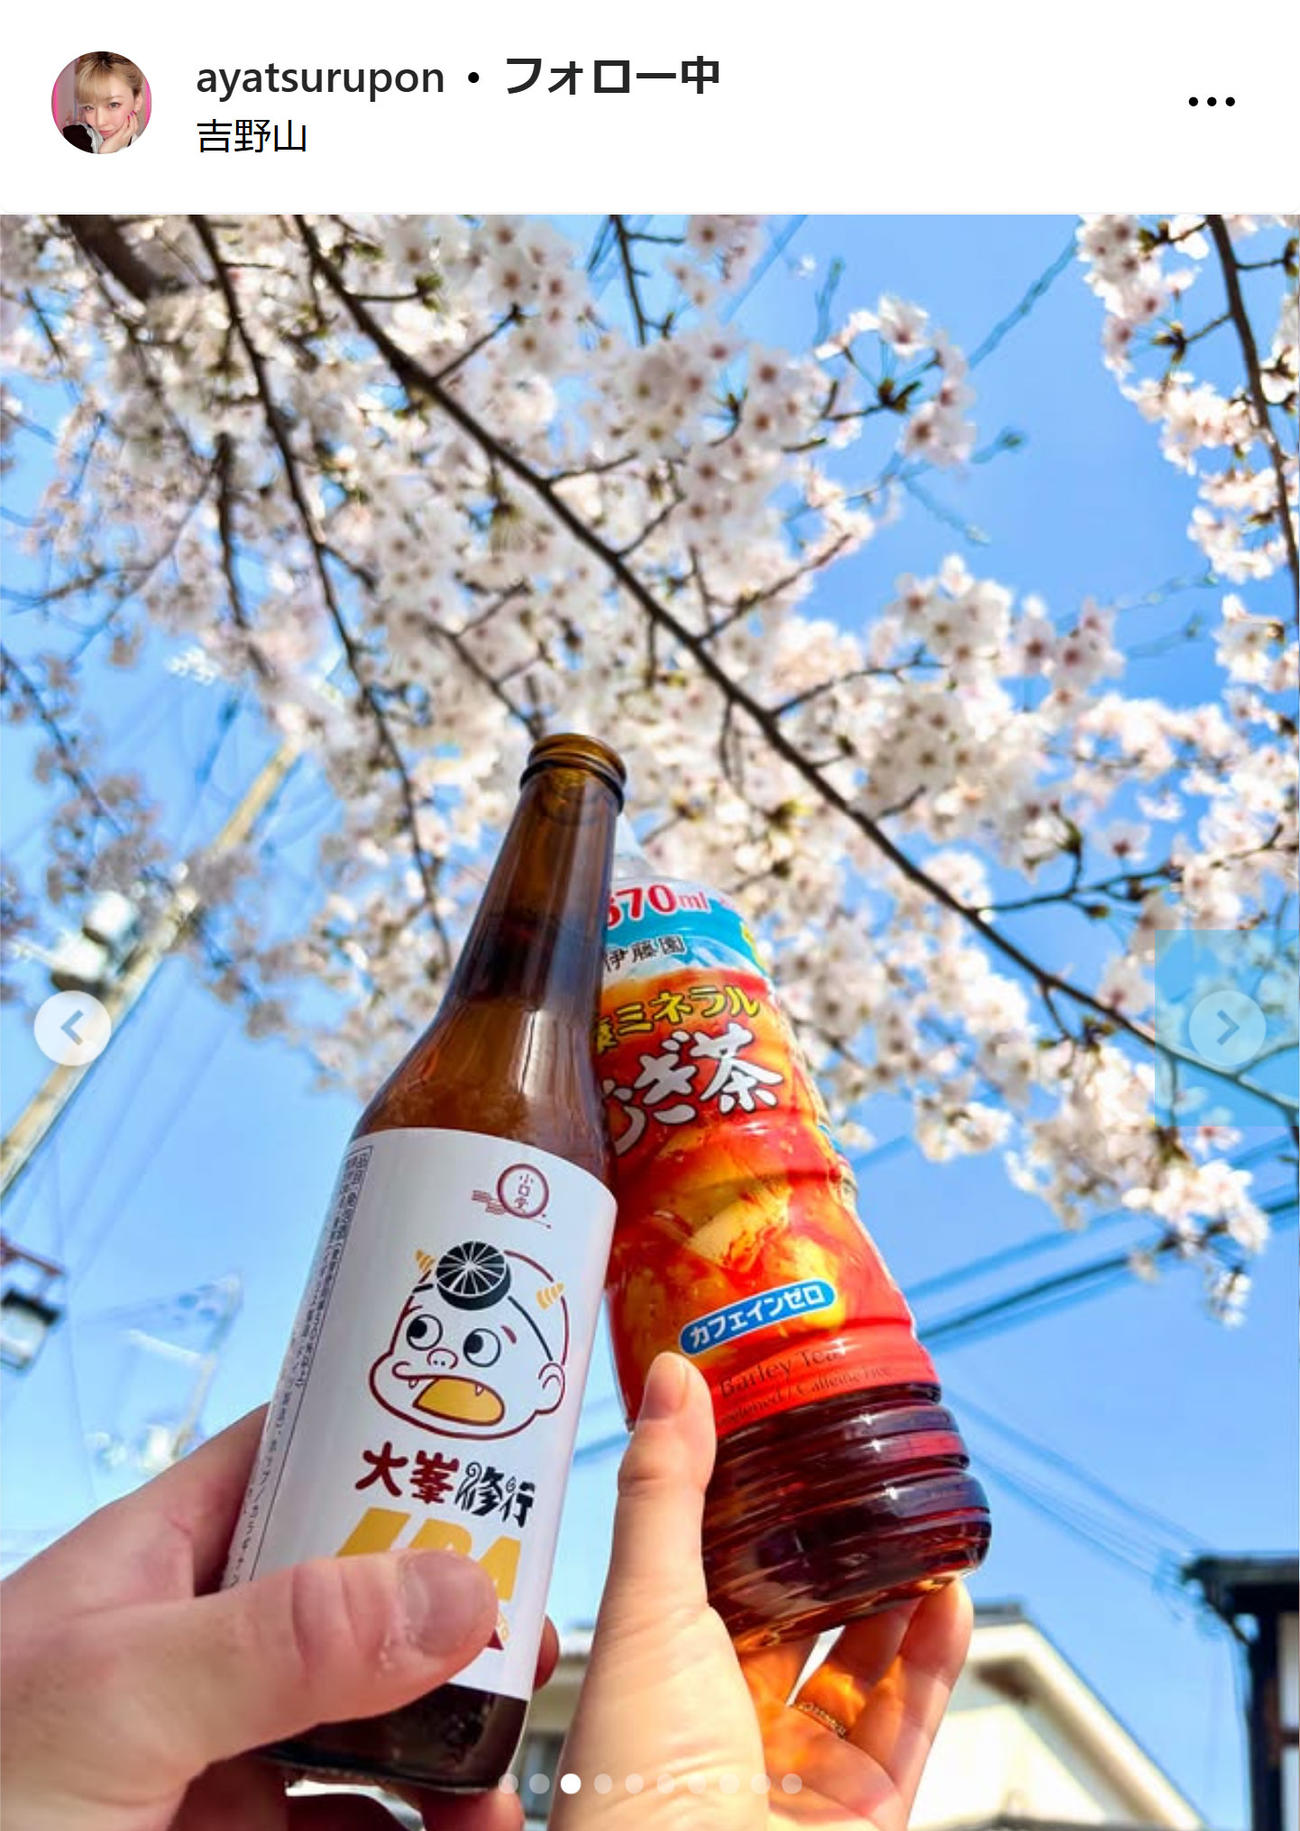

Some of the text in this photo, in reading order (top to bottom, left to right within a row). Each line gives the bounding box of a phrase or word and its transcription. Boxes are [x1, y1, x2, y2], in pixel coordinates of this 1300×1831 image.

[690, 1285, 825, 1348] カフェインゼロ
[719, 1358, 793, 1398] Barley
[355, 1441, 535, 1528] 大峯修行
